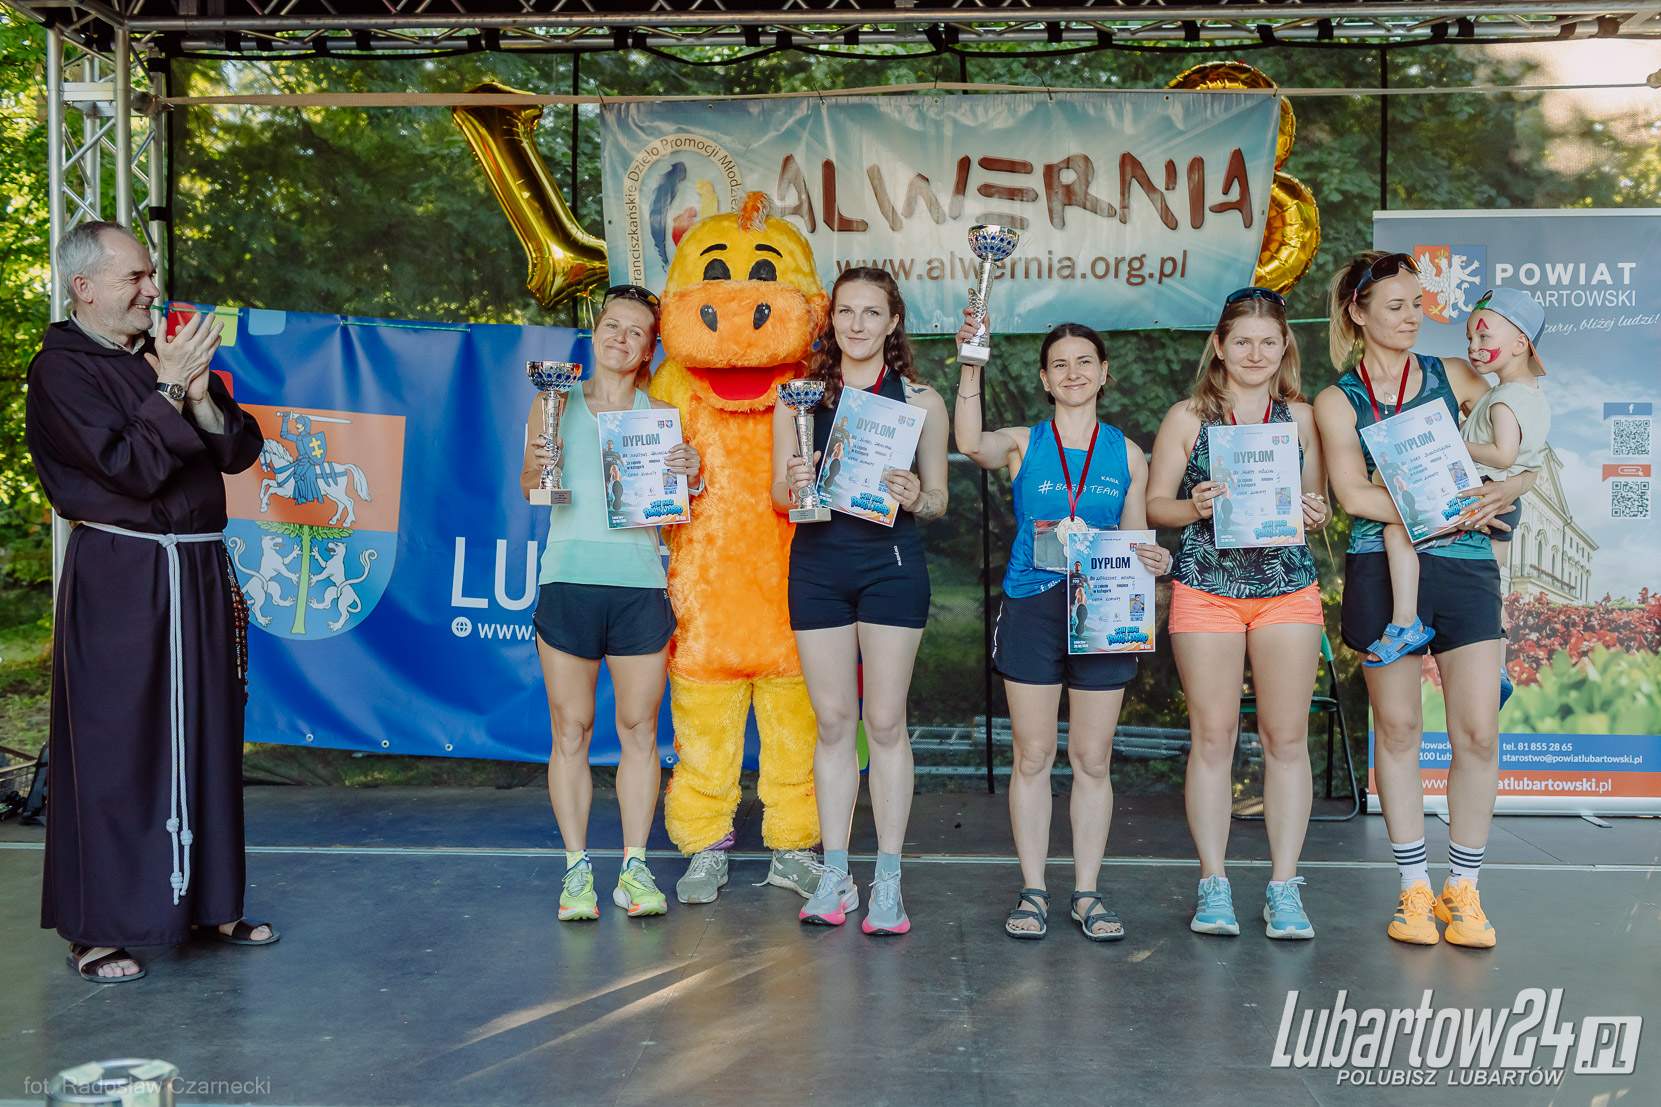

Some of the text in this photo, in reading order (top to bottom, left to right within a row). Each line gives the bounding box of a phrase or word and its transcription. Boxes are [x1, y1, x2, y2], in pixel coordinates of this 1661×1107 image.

[660, 137, 721, 158] Promocji
[776, 147, 1253, 234] ALWERNIA
[1495, 262, 1636, 286] POWIAT
[1580, 317, 1615, 332] bliżej
[1617, 313, 1660, 327] ludzi!
[856, 417, 896, 440] DYPLOM
[622, 433, 661, 448] DYPLOM
[1394, 430, 1436, 455] DYPLOM
[1233, 450, 1275, 464] DYPLOM
[1090, 485, 1119, 497] TEAM
[1091, 557, 1131, 569] DYPLOM
[1503, 742, 1516, 751] tel.
[1530, 742, 1548, 751] 855
[1548, 743, 1560, 751] 28
[1561, 743, 1573, 751] 65
[1502, 753, 1643, 764] starostwo@powiatlubartowski.pl
